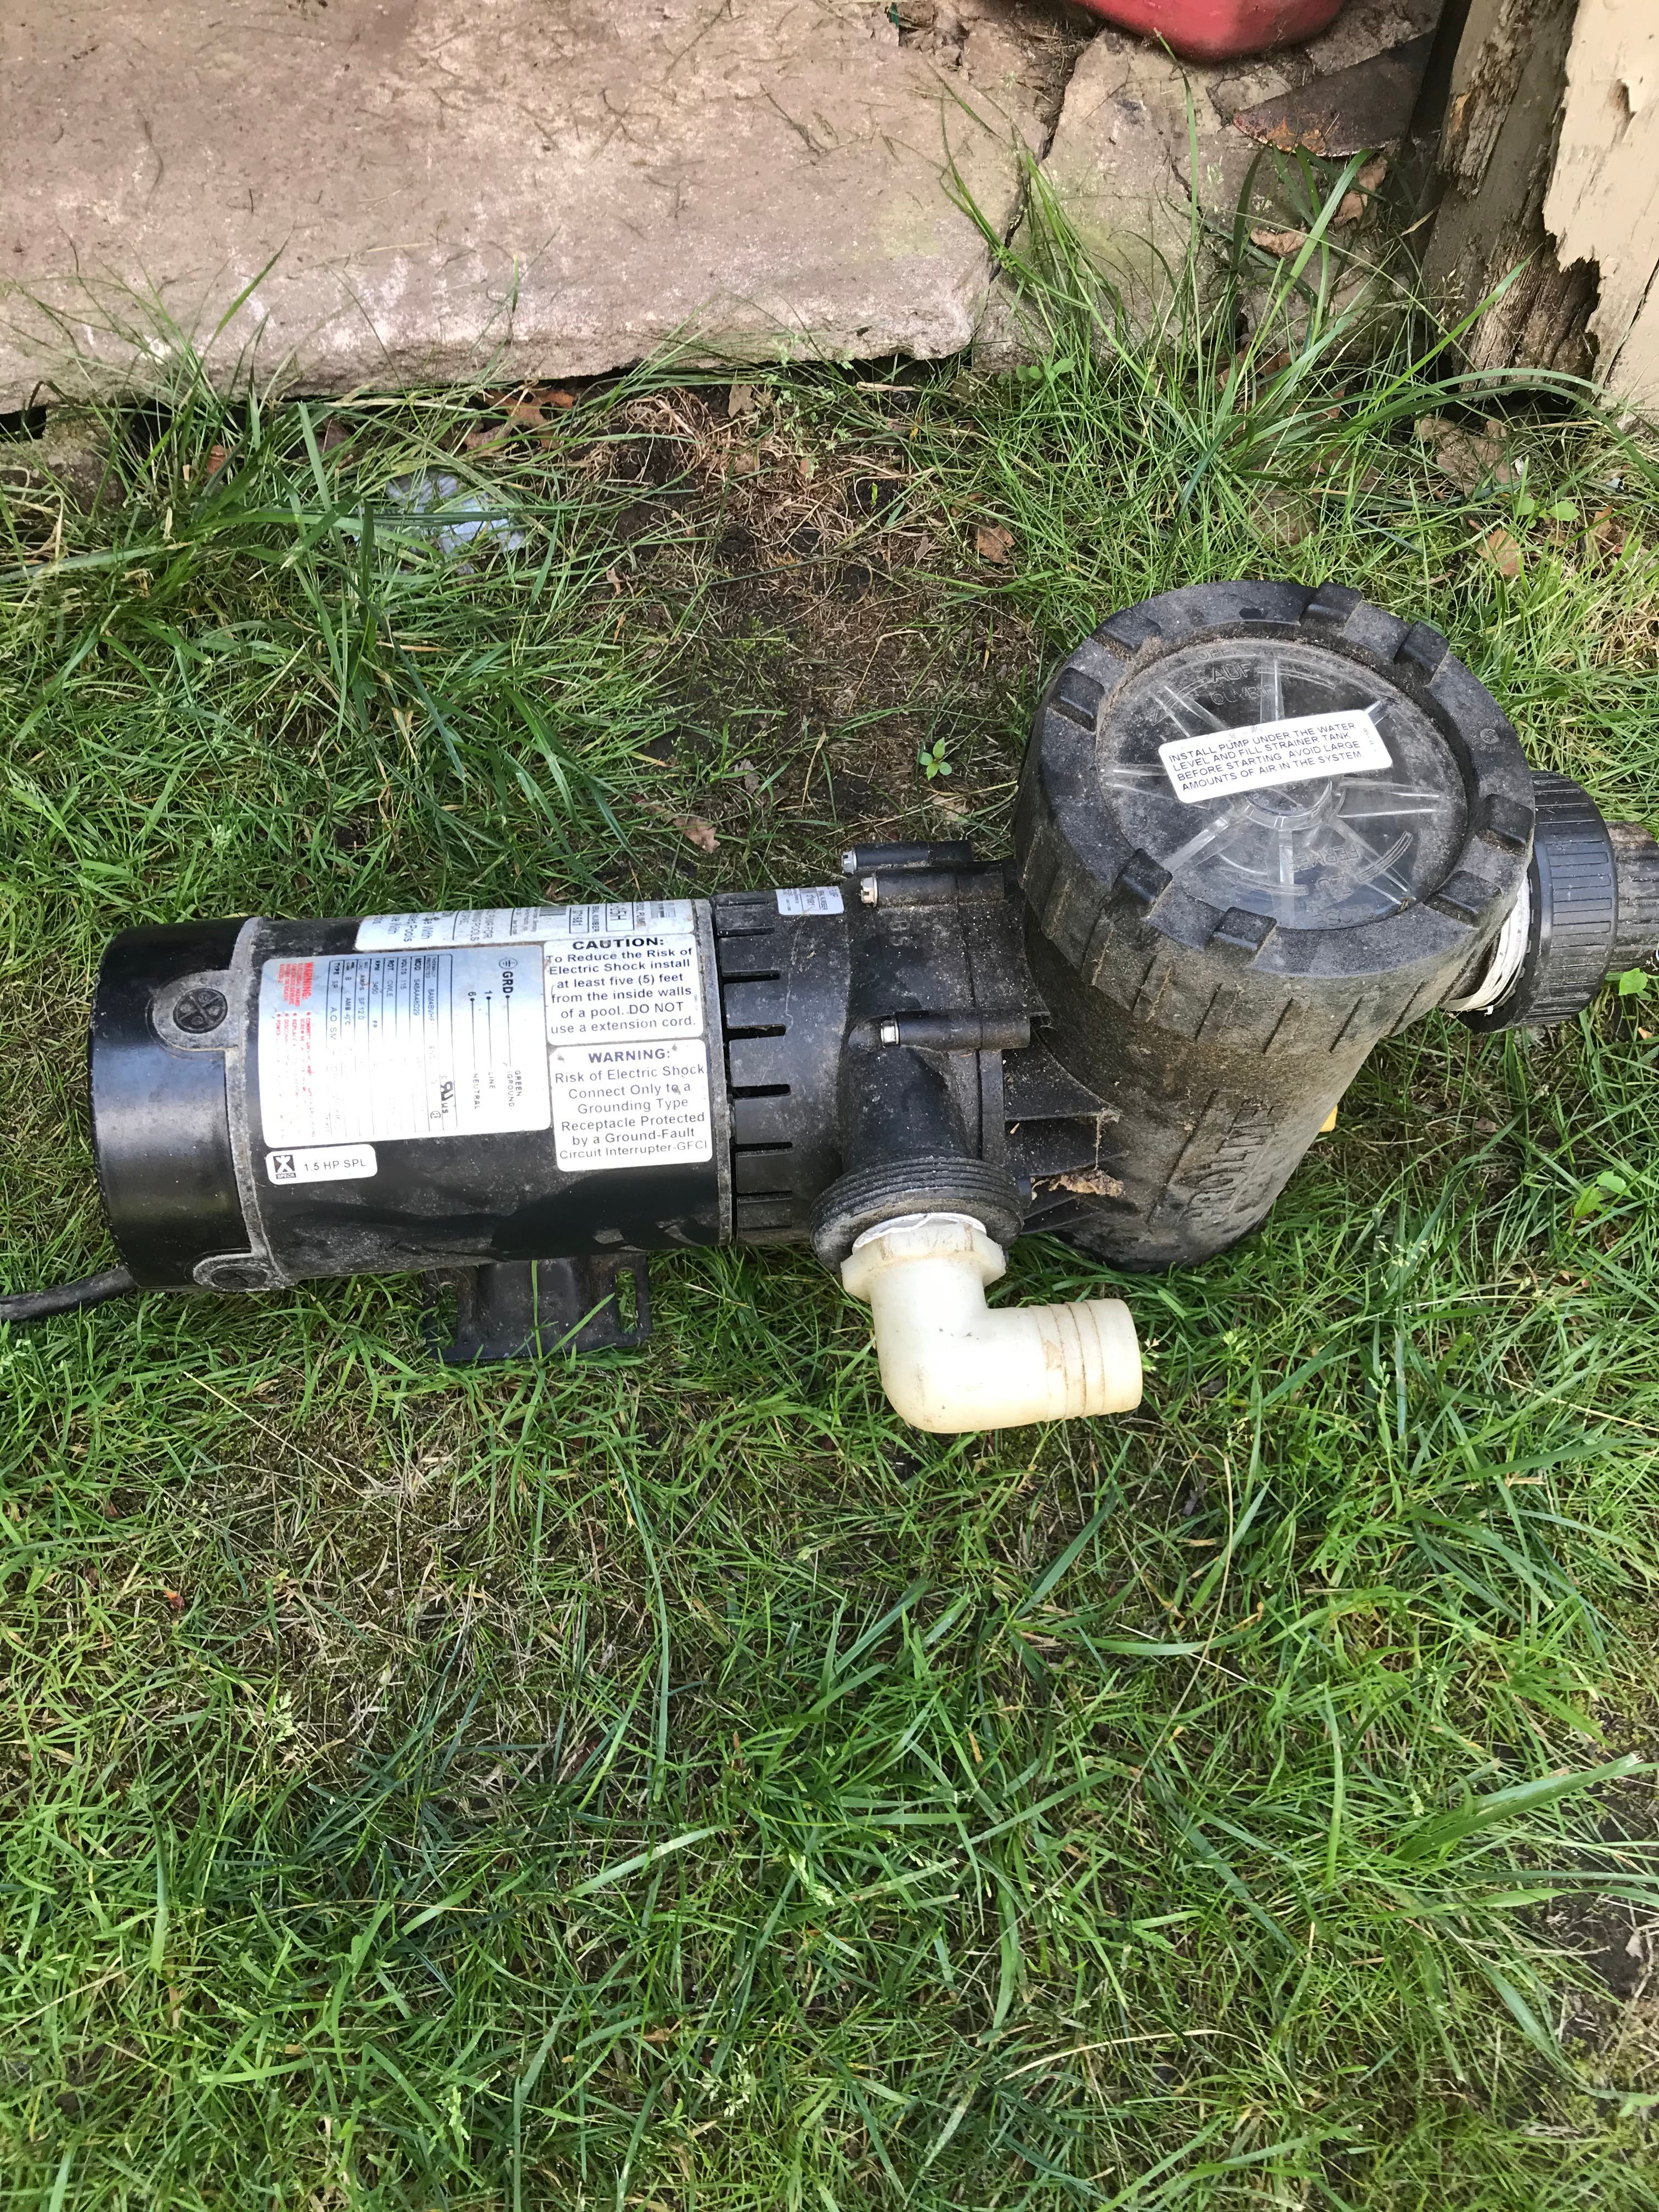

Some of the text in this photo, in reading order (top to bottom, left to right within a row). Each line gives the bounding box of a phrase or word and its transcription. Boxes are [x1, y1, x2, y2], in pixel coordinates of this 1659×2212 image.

[1212, 662, 1251, 684] AUF
[1169, 723, 1356, 763] INSTALL PUMP UNDER THE WATER
[1172, 757, 1210, 771] LEVEL
[1214, 752, 1237, 764] AND
[1239, 747, 1262, 759] FILL
[1265, 737, 1319, 753] STRAINER
[1322, 732, 1350, 743] TANK
[1178, 765, 1223, 781] BEFORE
[1289, 743, 1321, 758] AVOID
[1323, 740, 1360, 753] LARGE
[1182, 775, 1237, 792] AMOUNTS
[1240, 769, 1256, 779] OF
[1259, 764, 1277, 776] AIR
[1279, 763, 1291, 772] IN
[1293, 757, 1315, 770] THE
[404, 924, 417, 942] Pools
[421, 925, 433, 940] With
[470, 923, 481, 942] POOLS
[572, 937, 664, 950] CAUTION:
[567, 952, 617, 962] Reduce
[622, 950, 642, 958] the
[647, 949, 675, 958] Risk
[680, 947, 692, 956] of
[549, 958, 690, 975] Electric Shock install
[332, 980, 338, 989] SP
[502, 971, 514, 994] GRD
[557, 973, 684, 989] at least five (5) feet
[551, 986, 692, 1003] from the inside walls
[561, 1008, 573, 1018] of
[578, 1009, 585, 1018] a
[591, 1005, 624, 1019] pool.
[629, 1004, 650, 1014] DO
[654, 1001, 684, 1013] NOT
[551, 1015, 696, 1034] use a extension cord.
[588, 1048, 670, 1063] WARNING:
[514, 1070, 522, 1096] GREEN
[555, 1072, 584, 1084] Risk
[590, 1070, 602, 1081] of
[607, 1067, 658, 1080] Electric
[568, 1083, 691, 1099] Connect Only to a
[578, 1097, 689, 1114] Grounding Type
[561, 1112, 704, 1132] Receptacle Protected
[572, 1127, 695, 1147] by a Ground-Fault
[560, 1140, 707, 1159] Circuit Interrupter-GFCI
[304, 1159, 366, 1171] 1.5 HP SPL
